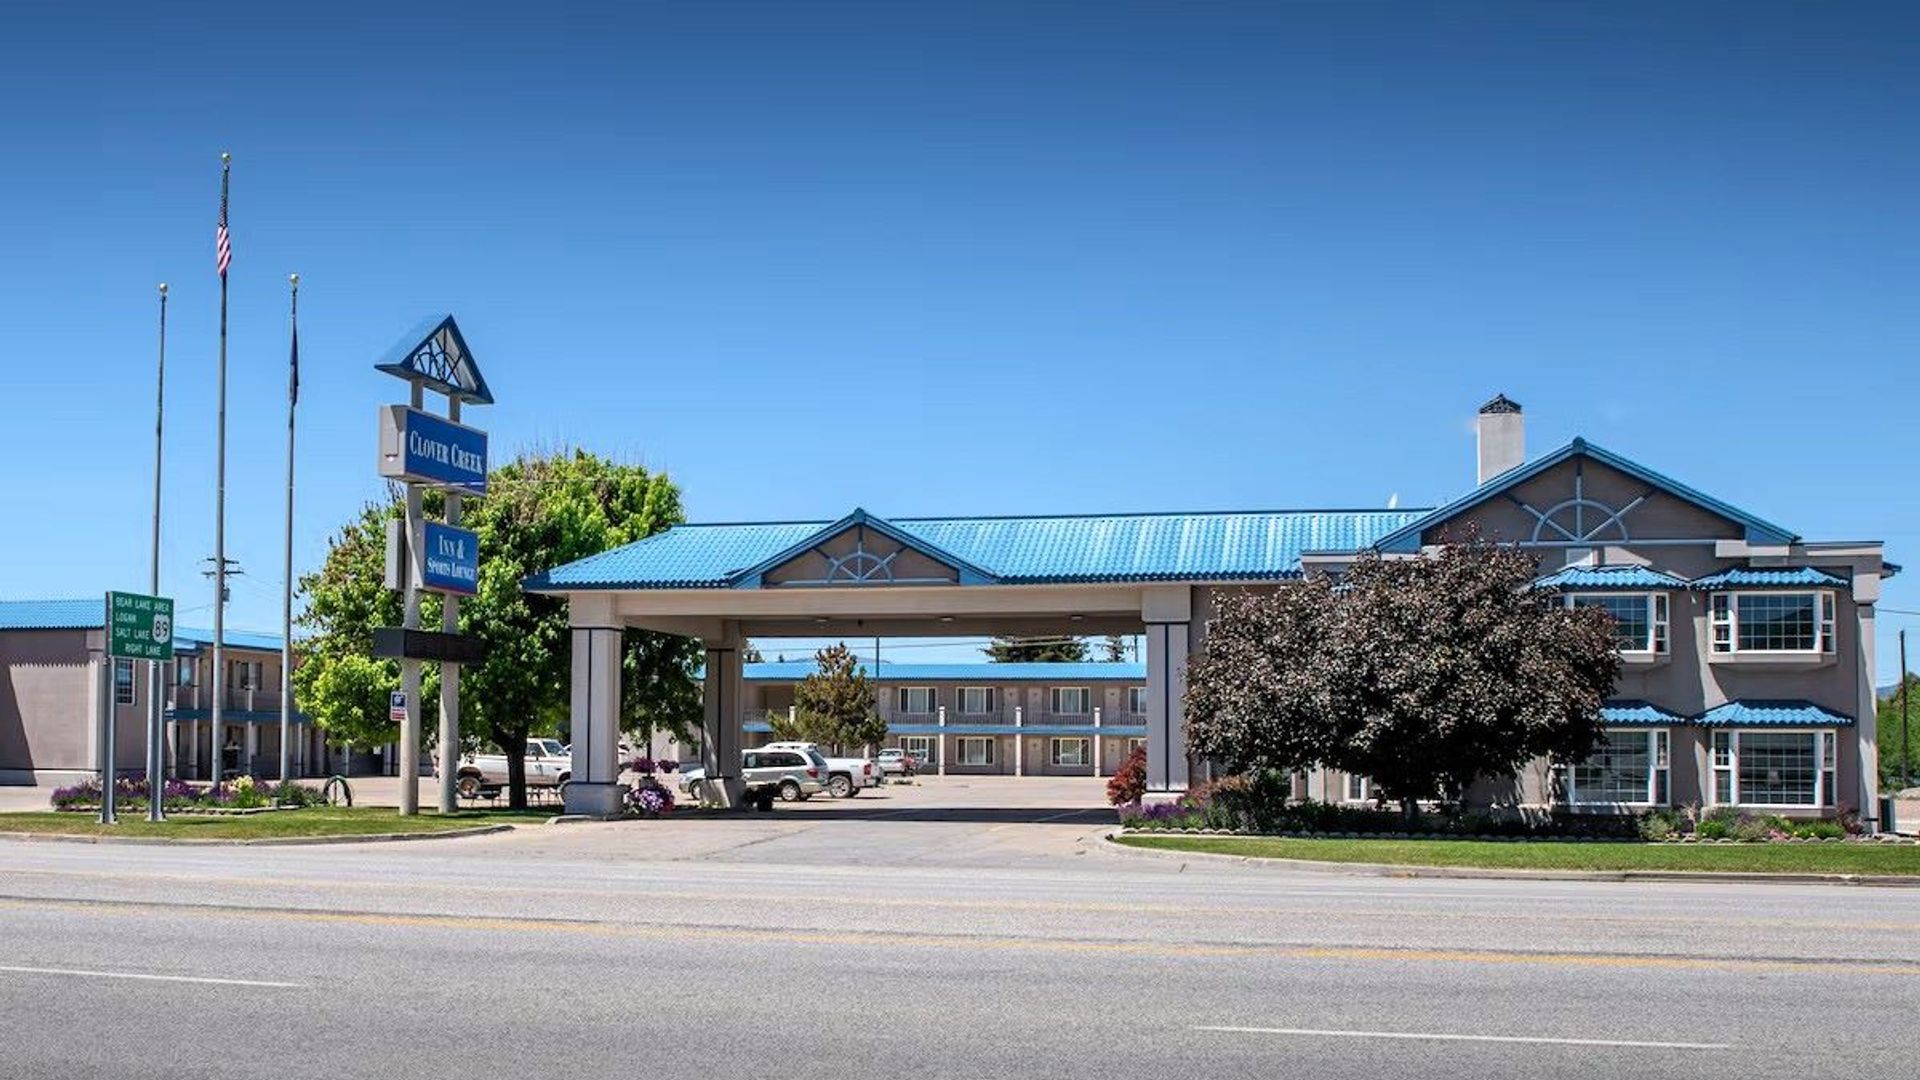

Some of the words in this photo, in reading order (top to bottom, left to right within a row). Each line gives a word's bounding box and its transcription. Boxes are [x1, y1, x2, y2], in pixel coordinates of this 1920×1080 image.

[410, 431, 449, 464] CLOVER
[451, 443, 483, 474] CREEK
[427, 557, 450, 577] SPORTS
[451, 562, 475, 581] LOUNGE
[116, 597, 132, 607] BEAR
[135, 600, 150, 610] LAKE
[154, 602, 169, 612] AREA
[115, 612, 137, 622] LOGAN
[115, 628, 131, 638] SALT
[134, 630, 150, 639] LAKE
[156, 620, 168, 637] 89
